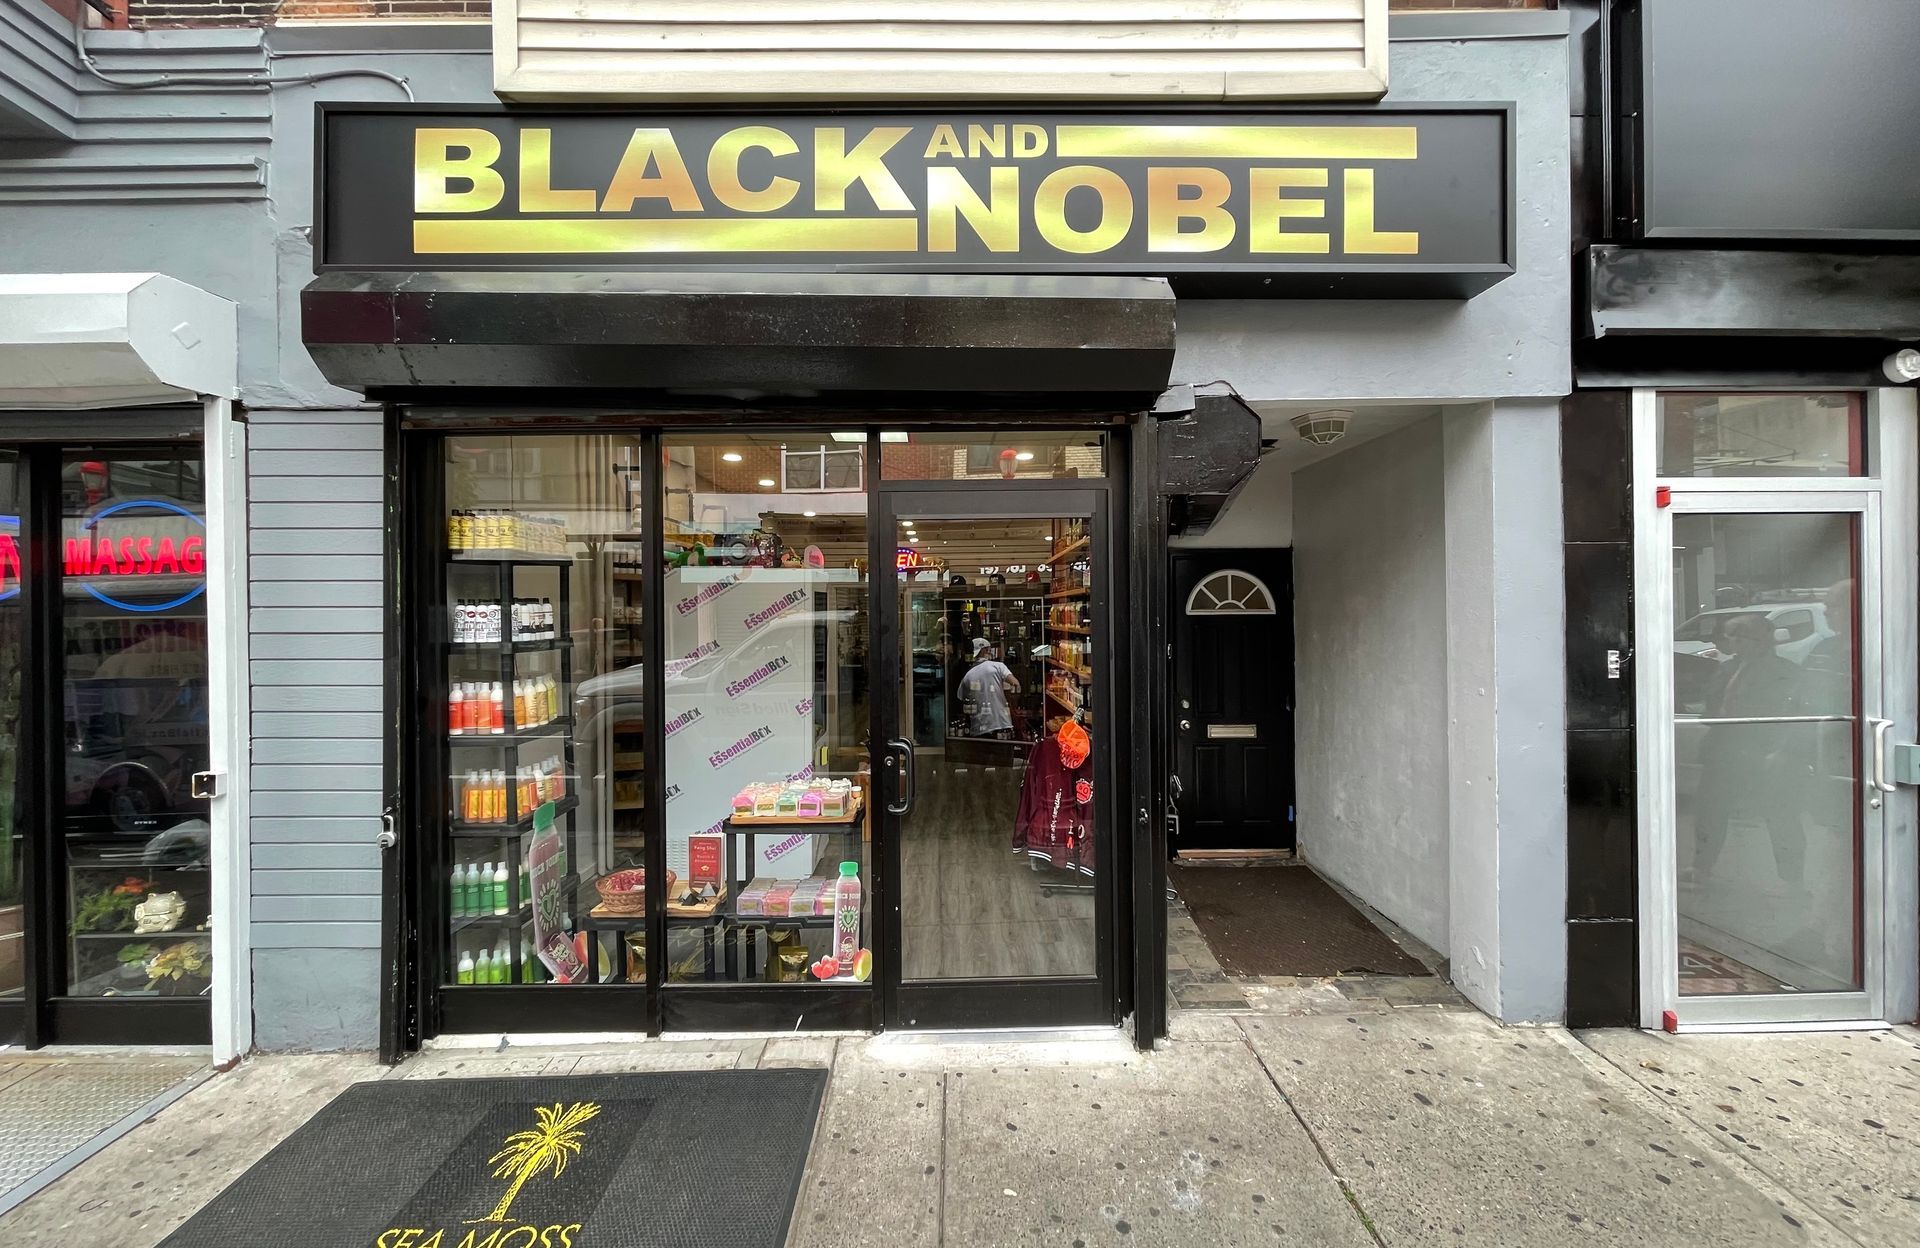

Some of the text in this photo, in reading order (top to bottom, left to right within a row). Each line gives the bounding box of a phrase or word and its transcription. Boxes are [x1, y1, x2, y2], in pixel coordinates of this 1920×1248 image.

[923, 124, 1049, 158] AND
[413, 127, 917, 213] BLACK
[927, 165, 1421, 255] NOBEL
[65, 535, 203, 575] MASSAG
[896, 553, 918, 567] EN
